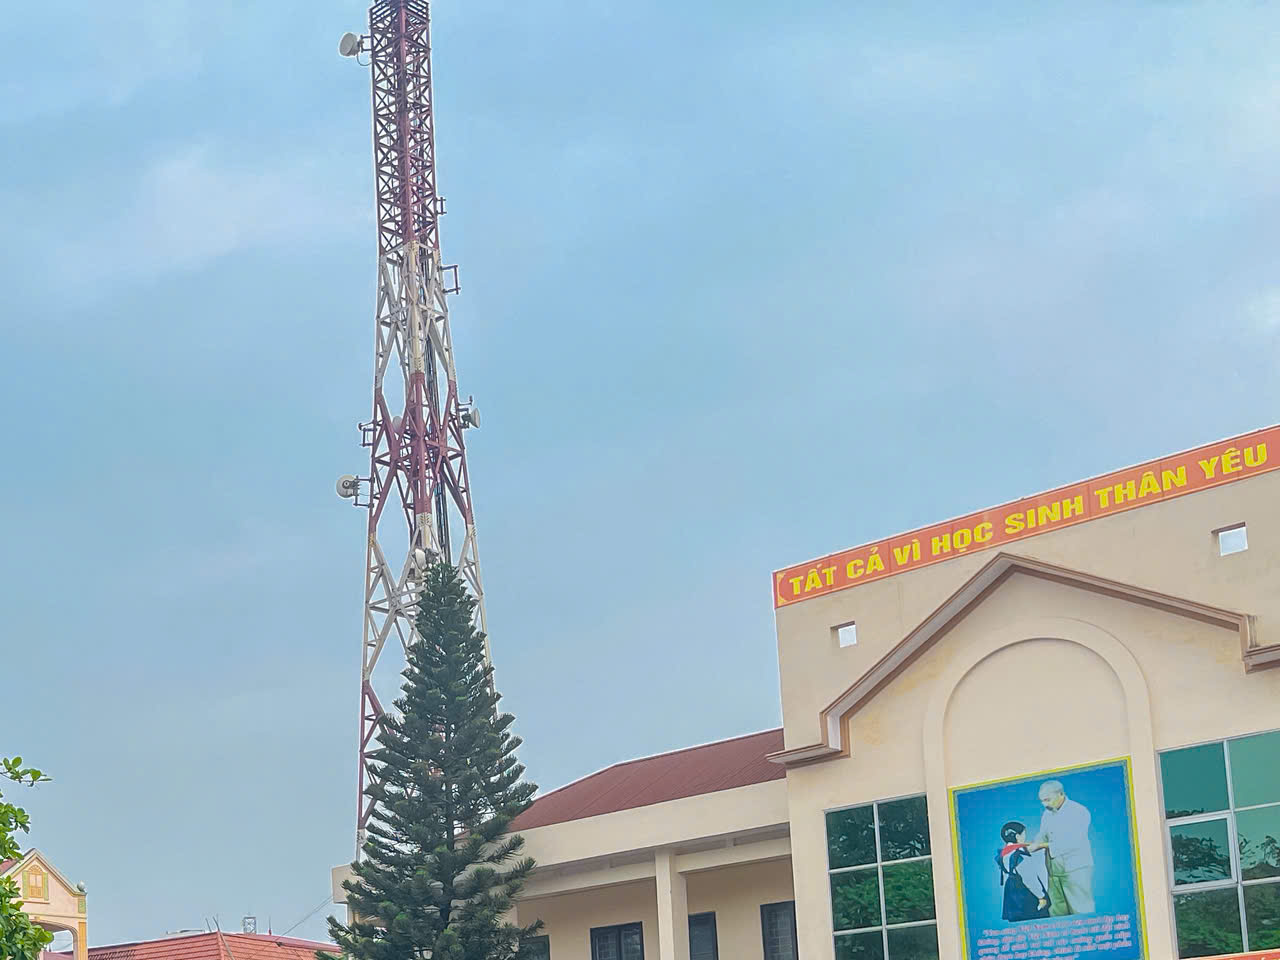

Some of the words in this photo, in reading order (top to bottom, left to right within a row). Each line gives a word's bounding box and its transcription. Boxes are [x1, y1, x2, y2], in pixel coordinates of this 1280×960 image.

[789, 563, 837, 595] TẤT
[846, 546, 885, 579] CẢ
[892, 538, 921, 566] VÌ
[931, 521, 993, 552] HỌC
[1004, 495, 1084, 535] SINH
[1094, 465, 1188, 509] THÂN
[1198, 443, 1268, 480] YÊU
